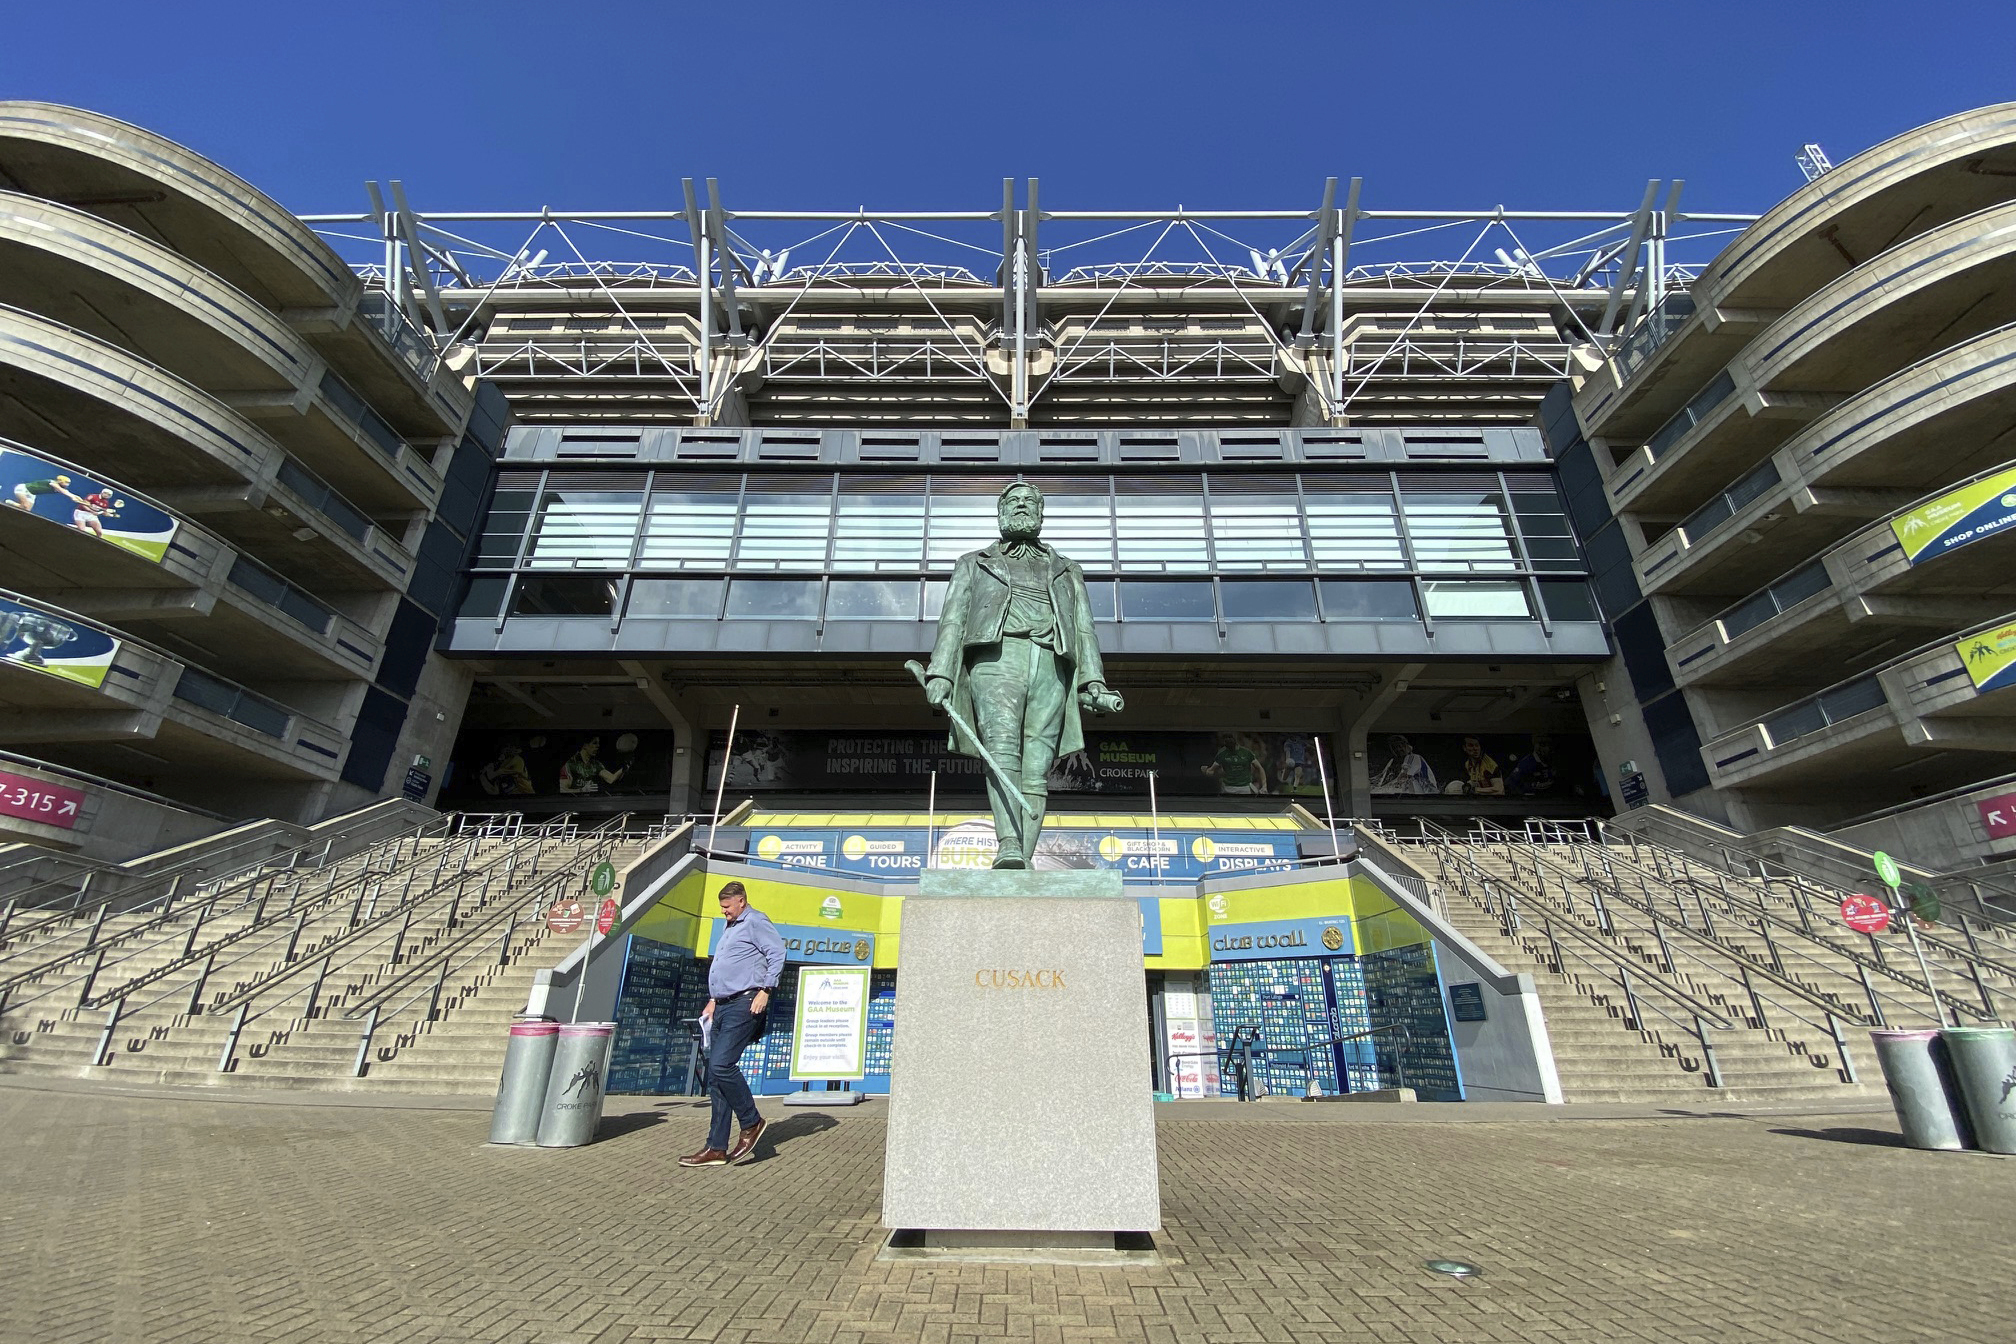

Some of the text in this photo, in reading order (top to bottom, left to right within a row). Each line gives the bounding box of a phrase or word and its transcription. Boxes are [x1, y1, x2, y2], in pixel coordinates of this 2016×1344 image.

[1943, 530, 1974, 547] SHOP
[828, 739, 948, 754] PROTECTING THE
[1100, 741, 1128, 751] GAA
[1100, 753, 1156, 763] MUSEUM
[826, 758, 897, 774] INSPIRING
[903, 758, 931, 774] THE
[1100, 768, 1160, 778] CROKE PARK
[944, 836, 999, 847] WHERE HIST
[782, 856, 827, 868] ZONE
[868, 856, 921, 868] TOURS
[940, 847, 998, 867] BURS
[1127, 856, 1170, 869] CAFE
[1218, 858, 1292, 871] DISPLAYS
[975, 968, 1067, 988] CUSACK
[556, 1102, 581, 1110] CROKE
